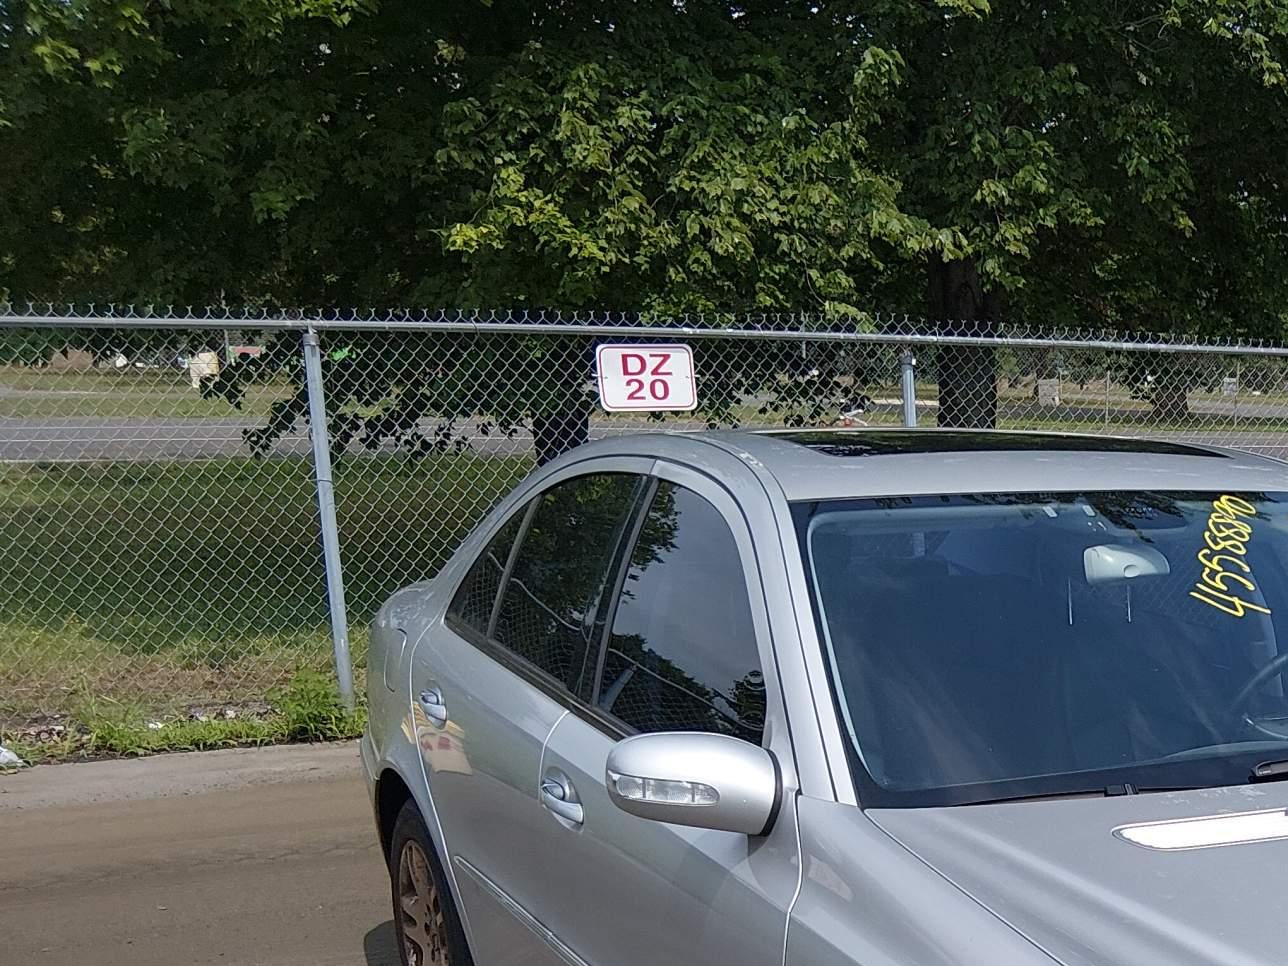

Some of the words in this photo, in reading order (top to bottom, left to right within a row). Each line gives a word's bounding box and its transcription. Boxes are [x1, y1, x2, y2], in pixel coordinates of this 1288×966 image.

[621, 353, 673, 376] DZ
[625, 378, 670, 400] 20
[1189, 494, 1271, 617] 45588890
